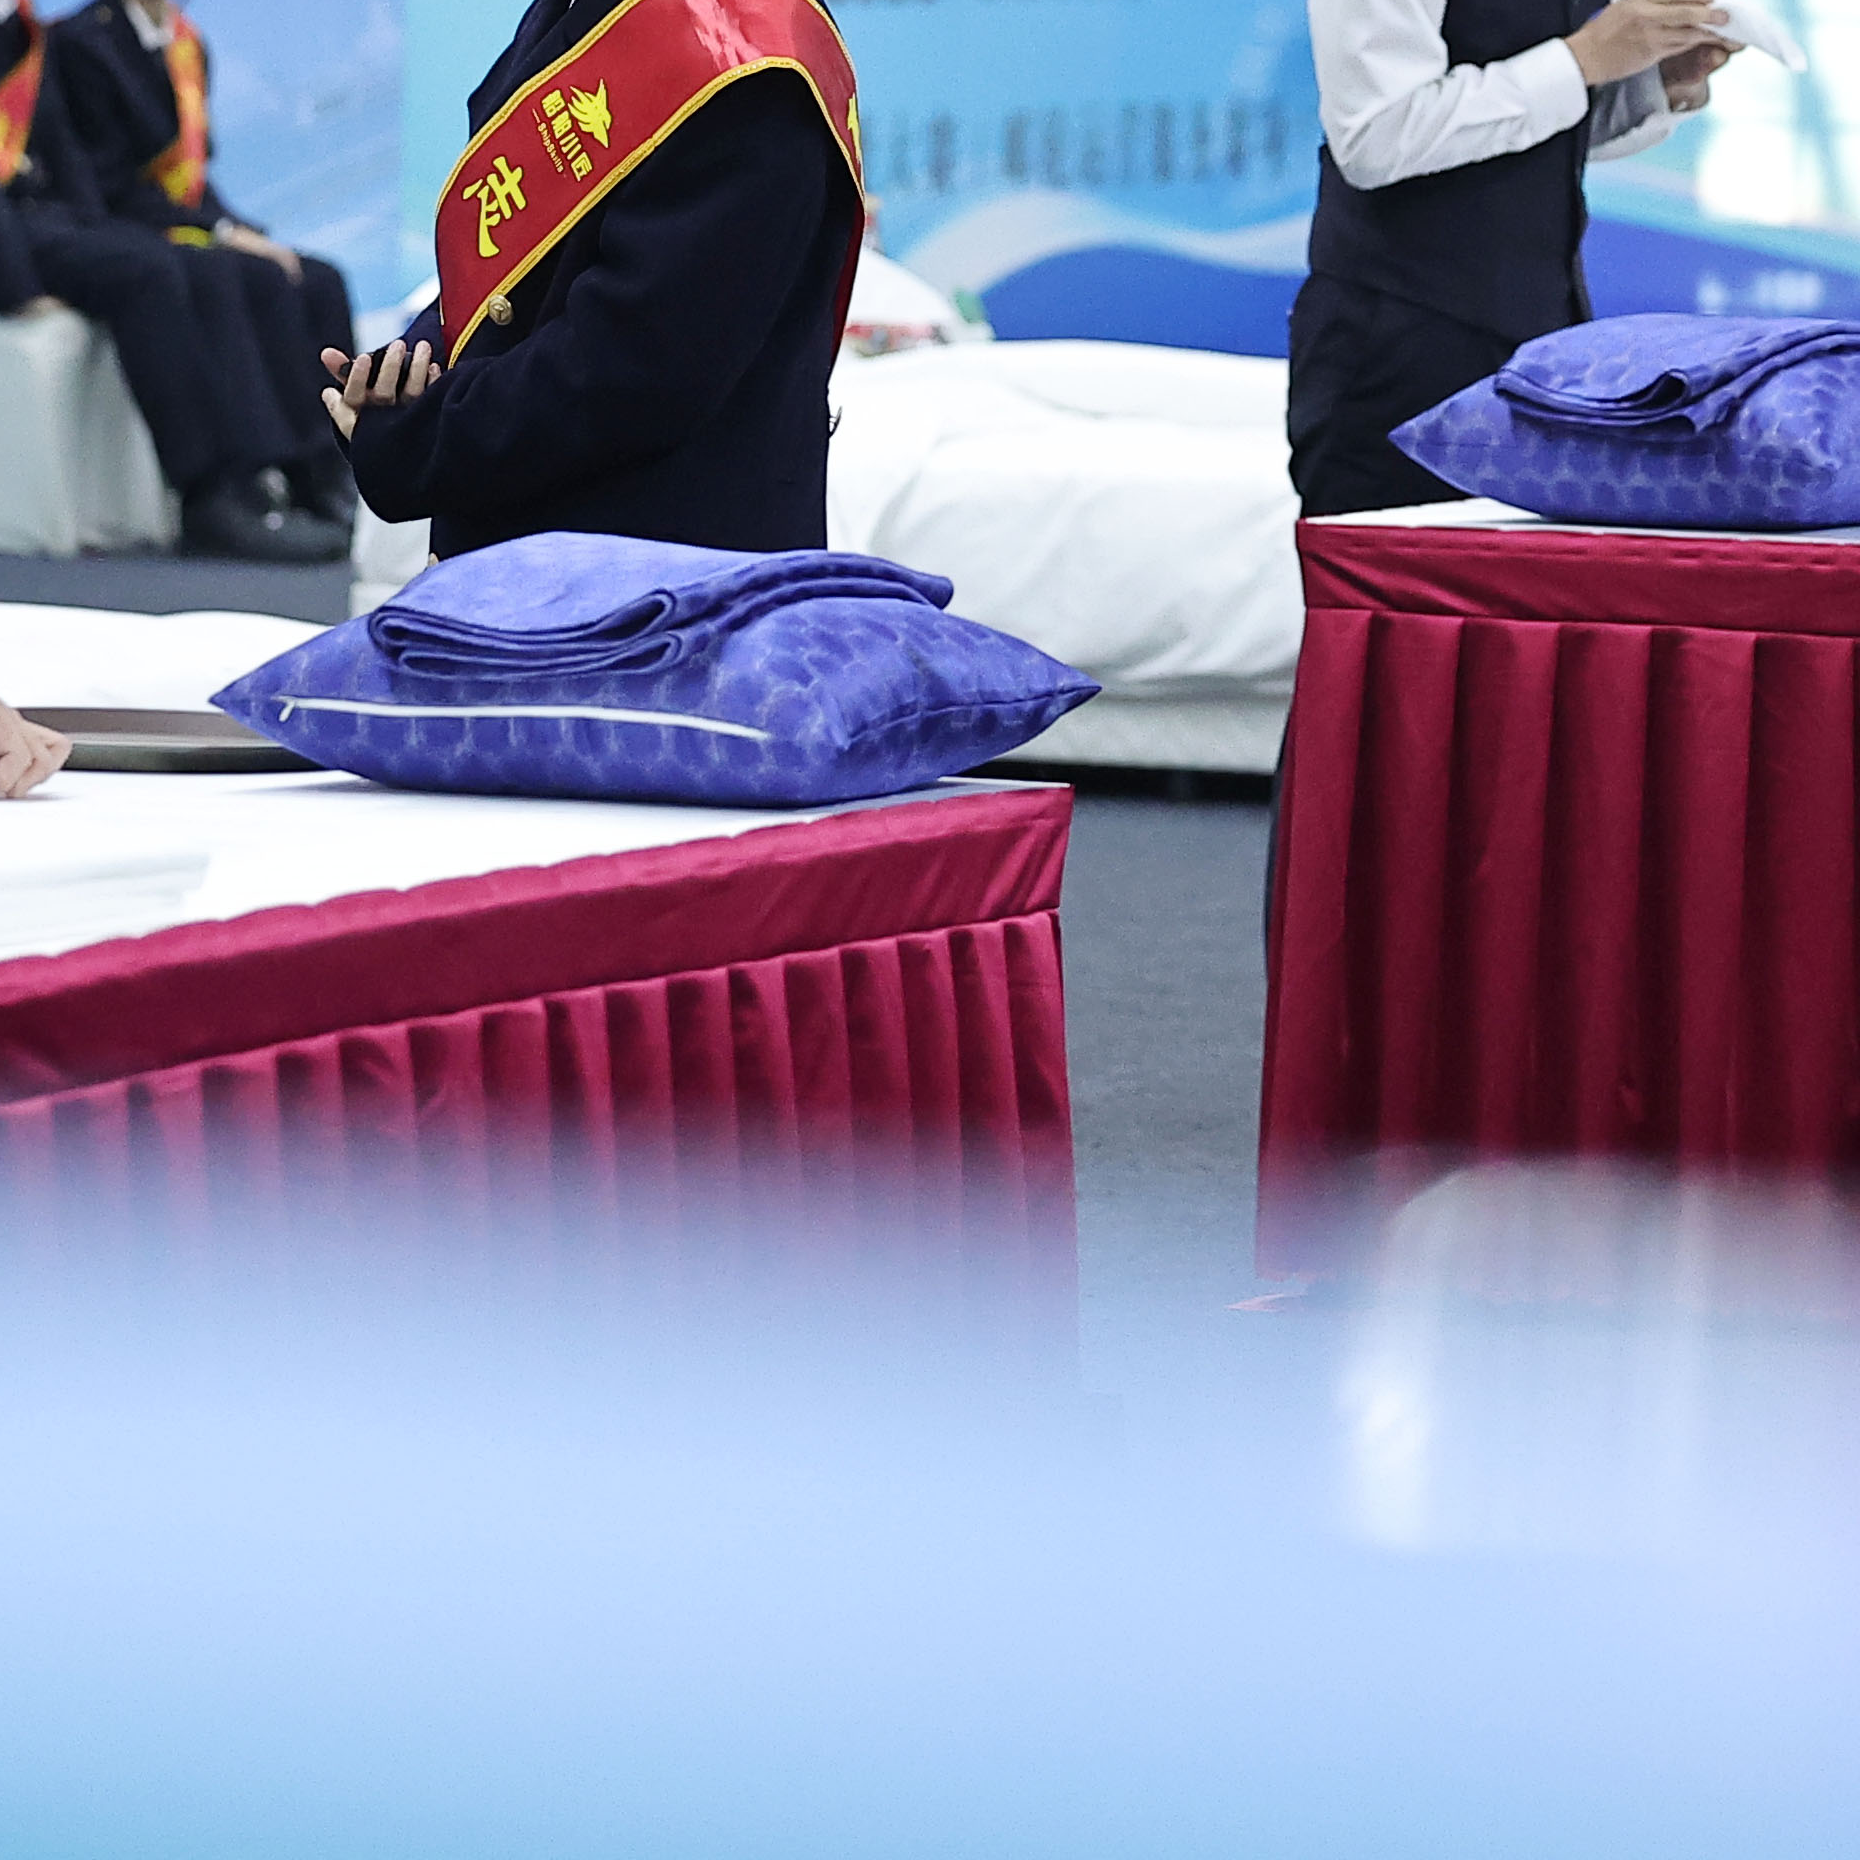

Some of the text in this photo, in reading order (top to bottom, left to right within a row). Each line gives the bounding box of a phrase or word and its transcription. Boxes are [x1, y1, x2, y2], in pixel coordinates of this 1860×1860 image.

[537, 122, 565, 174] ShipSkills
[541, 89, 593, 182] 船舶小匠
[462, 155, 527, 258] 志
